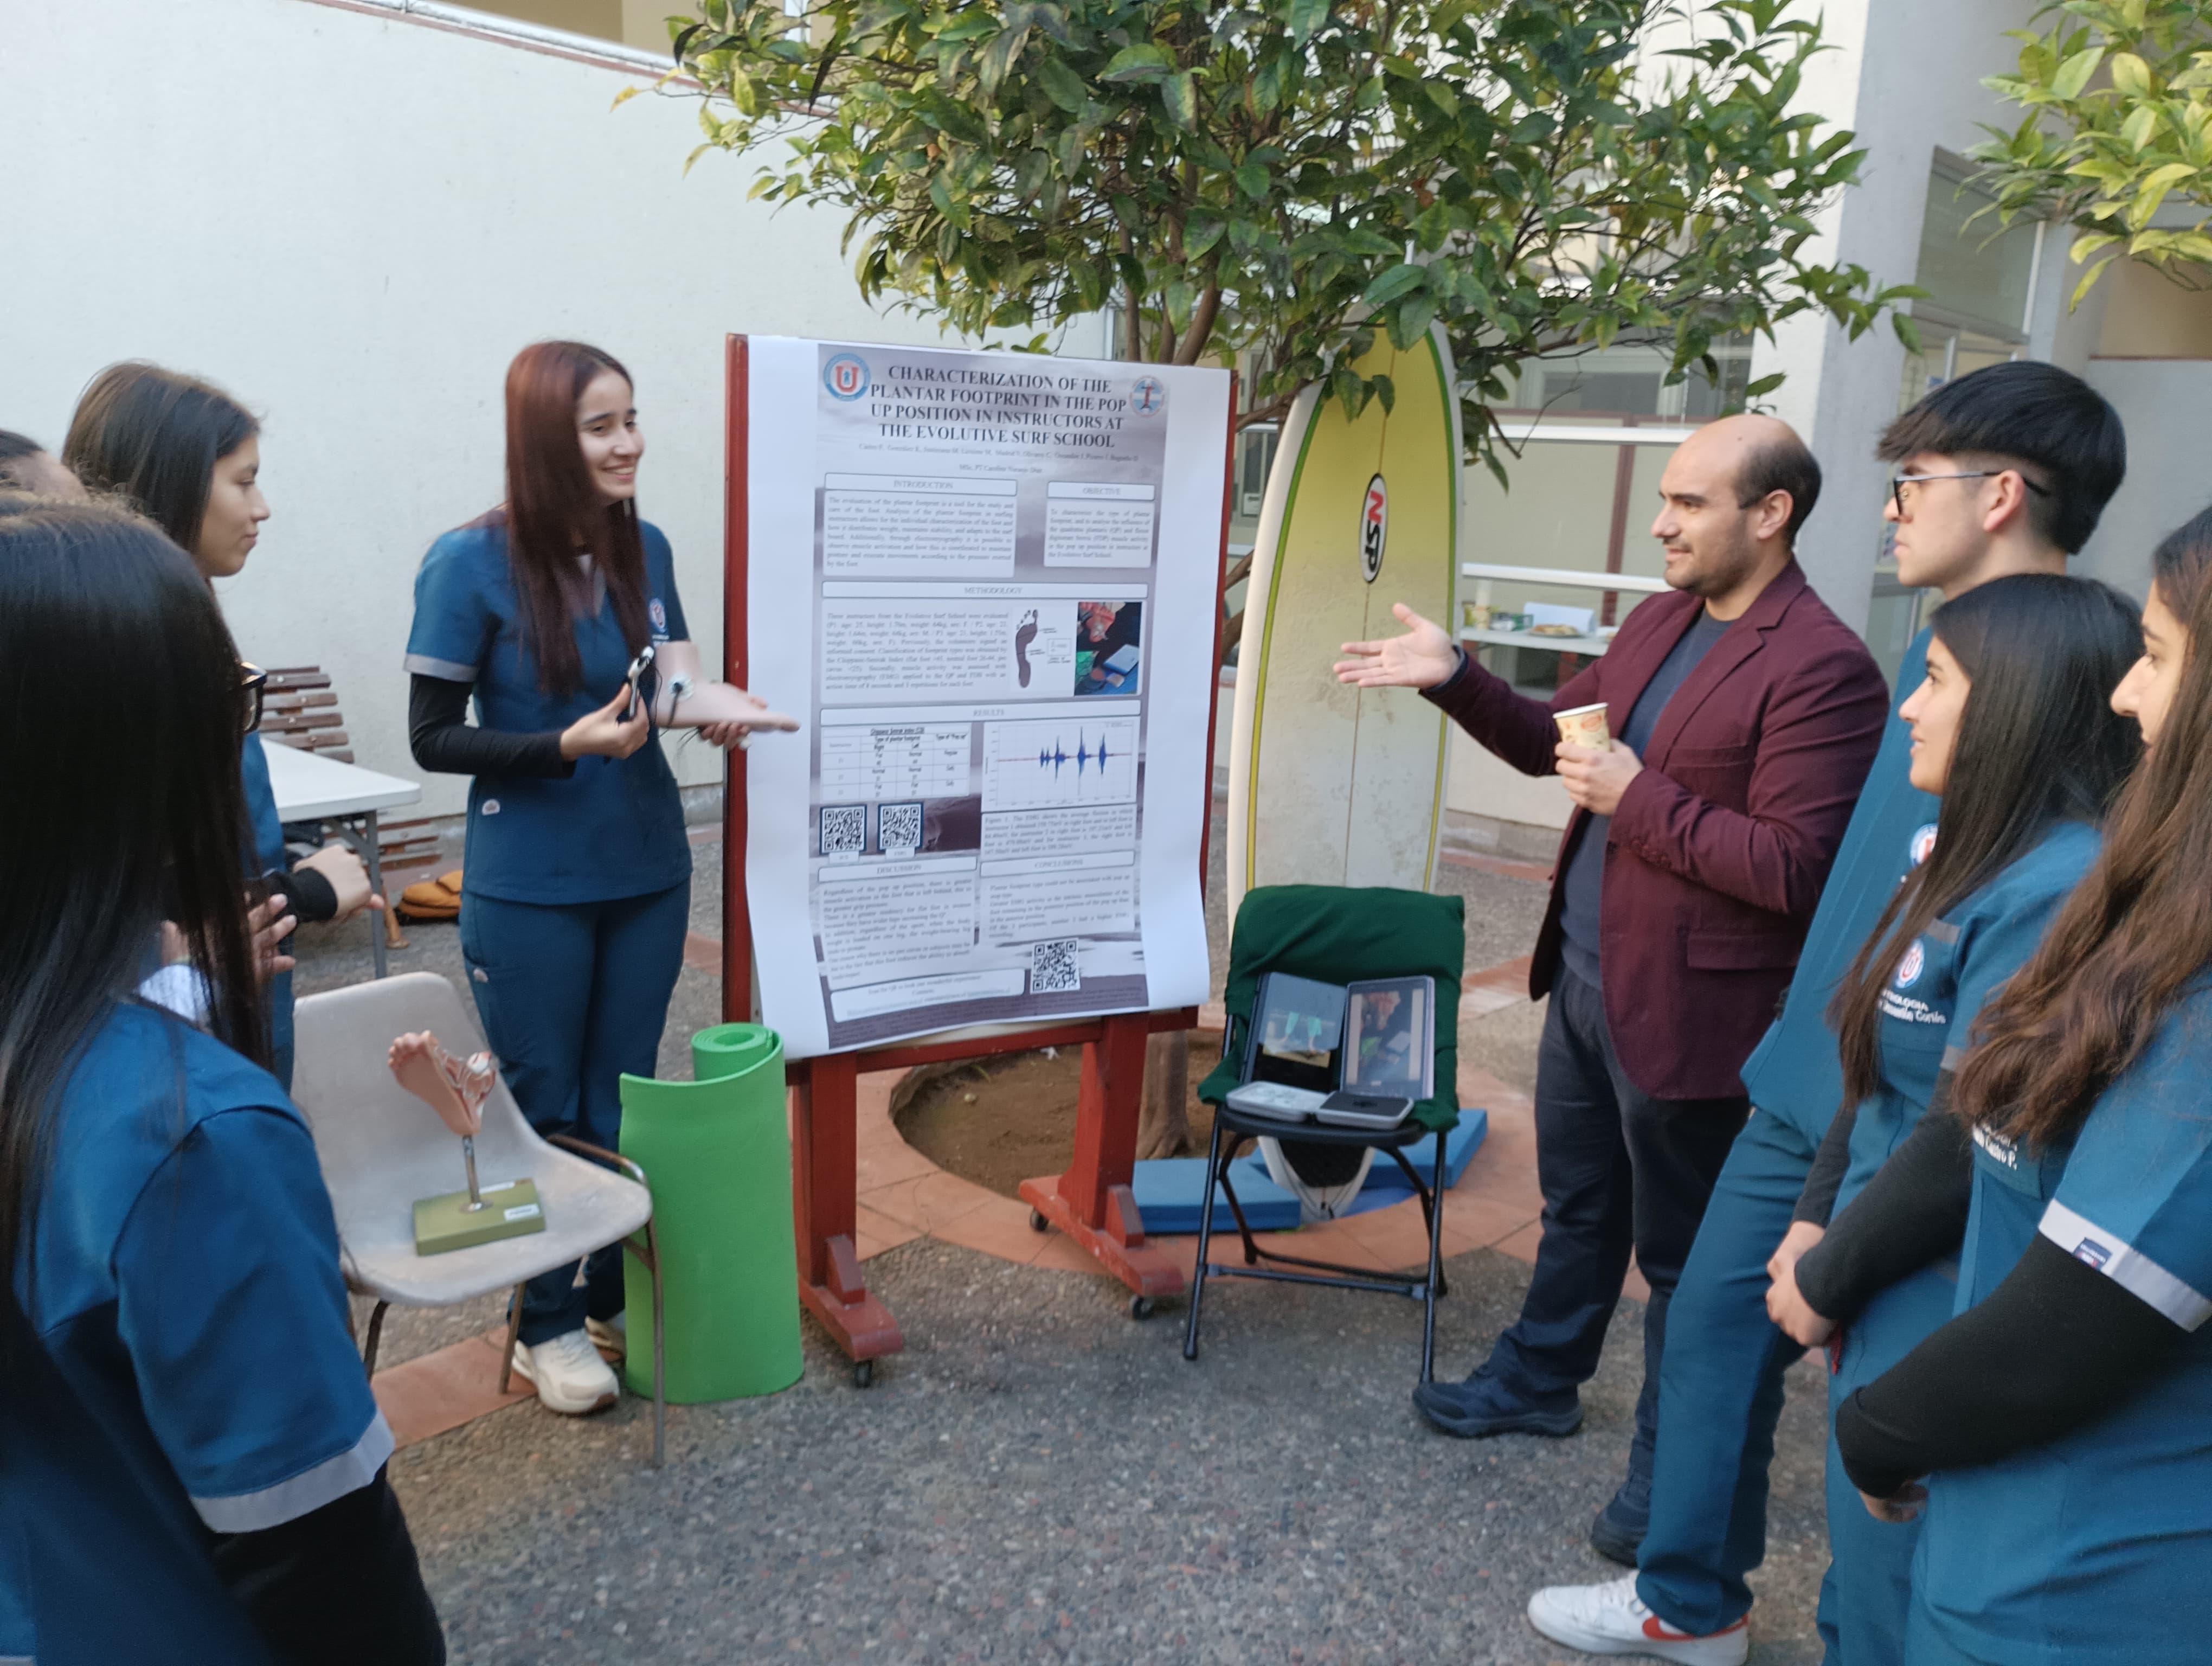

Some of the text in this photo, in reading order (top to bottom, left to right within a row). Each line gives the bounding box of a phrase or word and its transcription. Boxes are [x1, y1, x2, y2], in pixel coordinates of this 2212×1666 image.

[889, 366, 1111, 393] CHARACTERIZATION OF THE
[871, 384, 1127, 412] PLANTAR FOOTPRINT IN THE POP
[871, 403, 1124, 430] UP POSITION IN INSTRUCTORS AT
[878, 423, 1115, 447] THE EVOLUTIVE SURF SCHOOL
[893, 480, 953, 490] INTRODUCTION
[1083, 487, 1121, 496] OBJECTIVE
[1365, 490, 1384, 572] NSP
[964, 586, 1022, 595] METHODOLOGY
